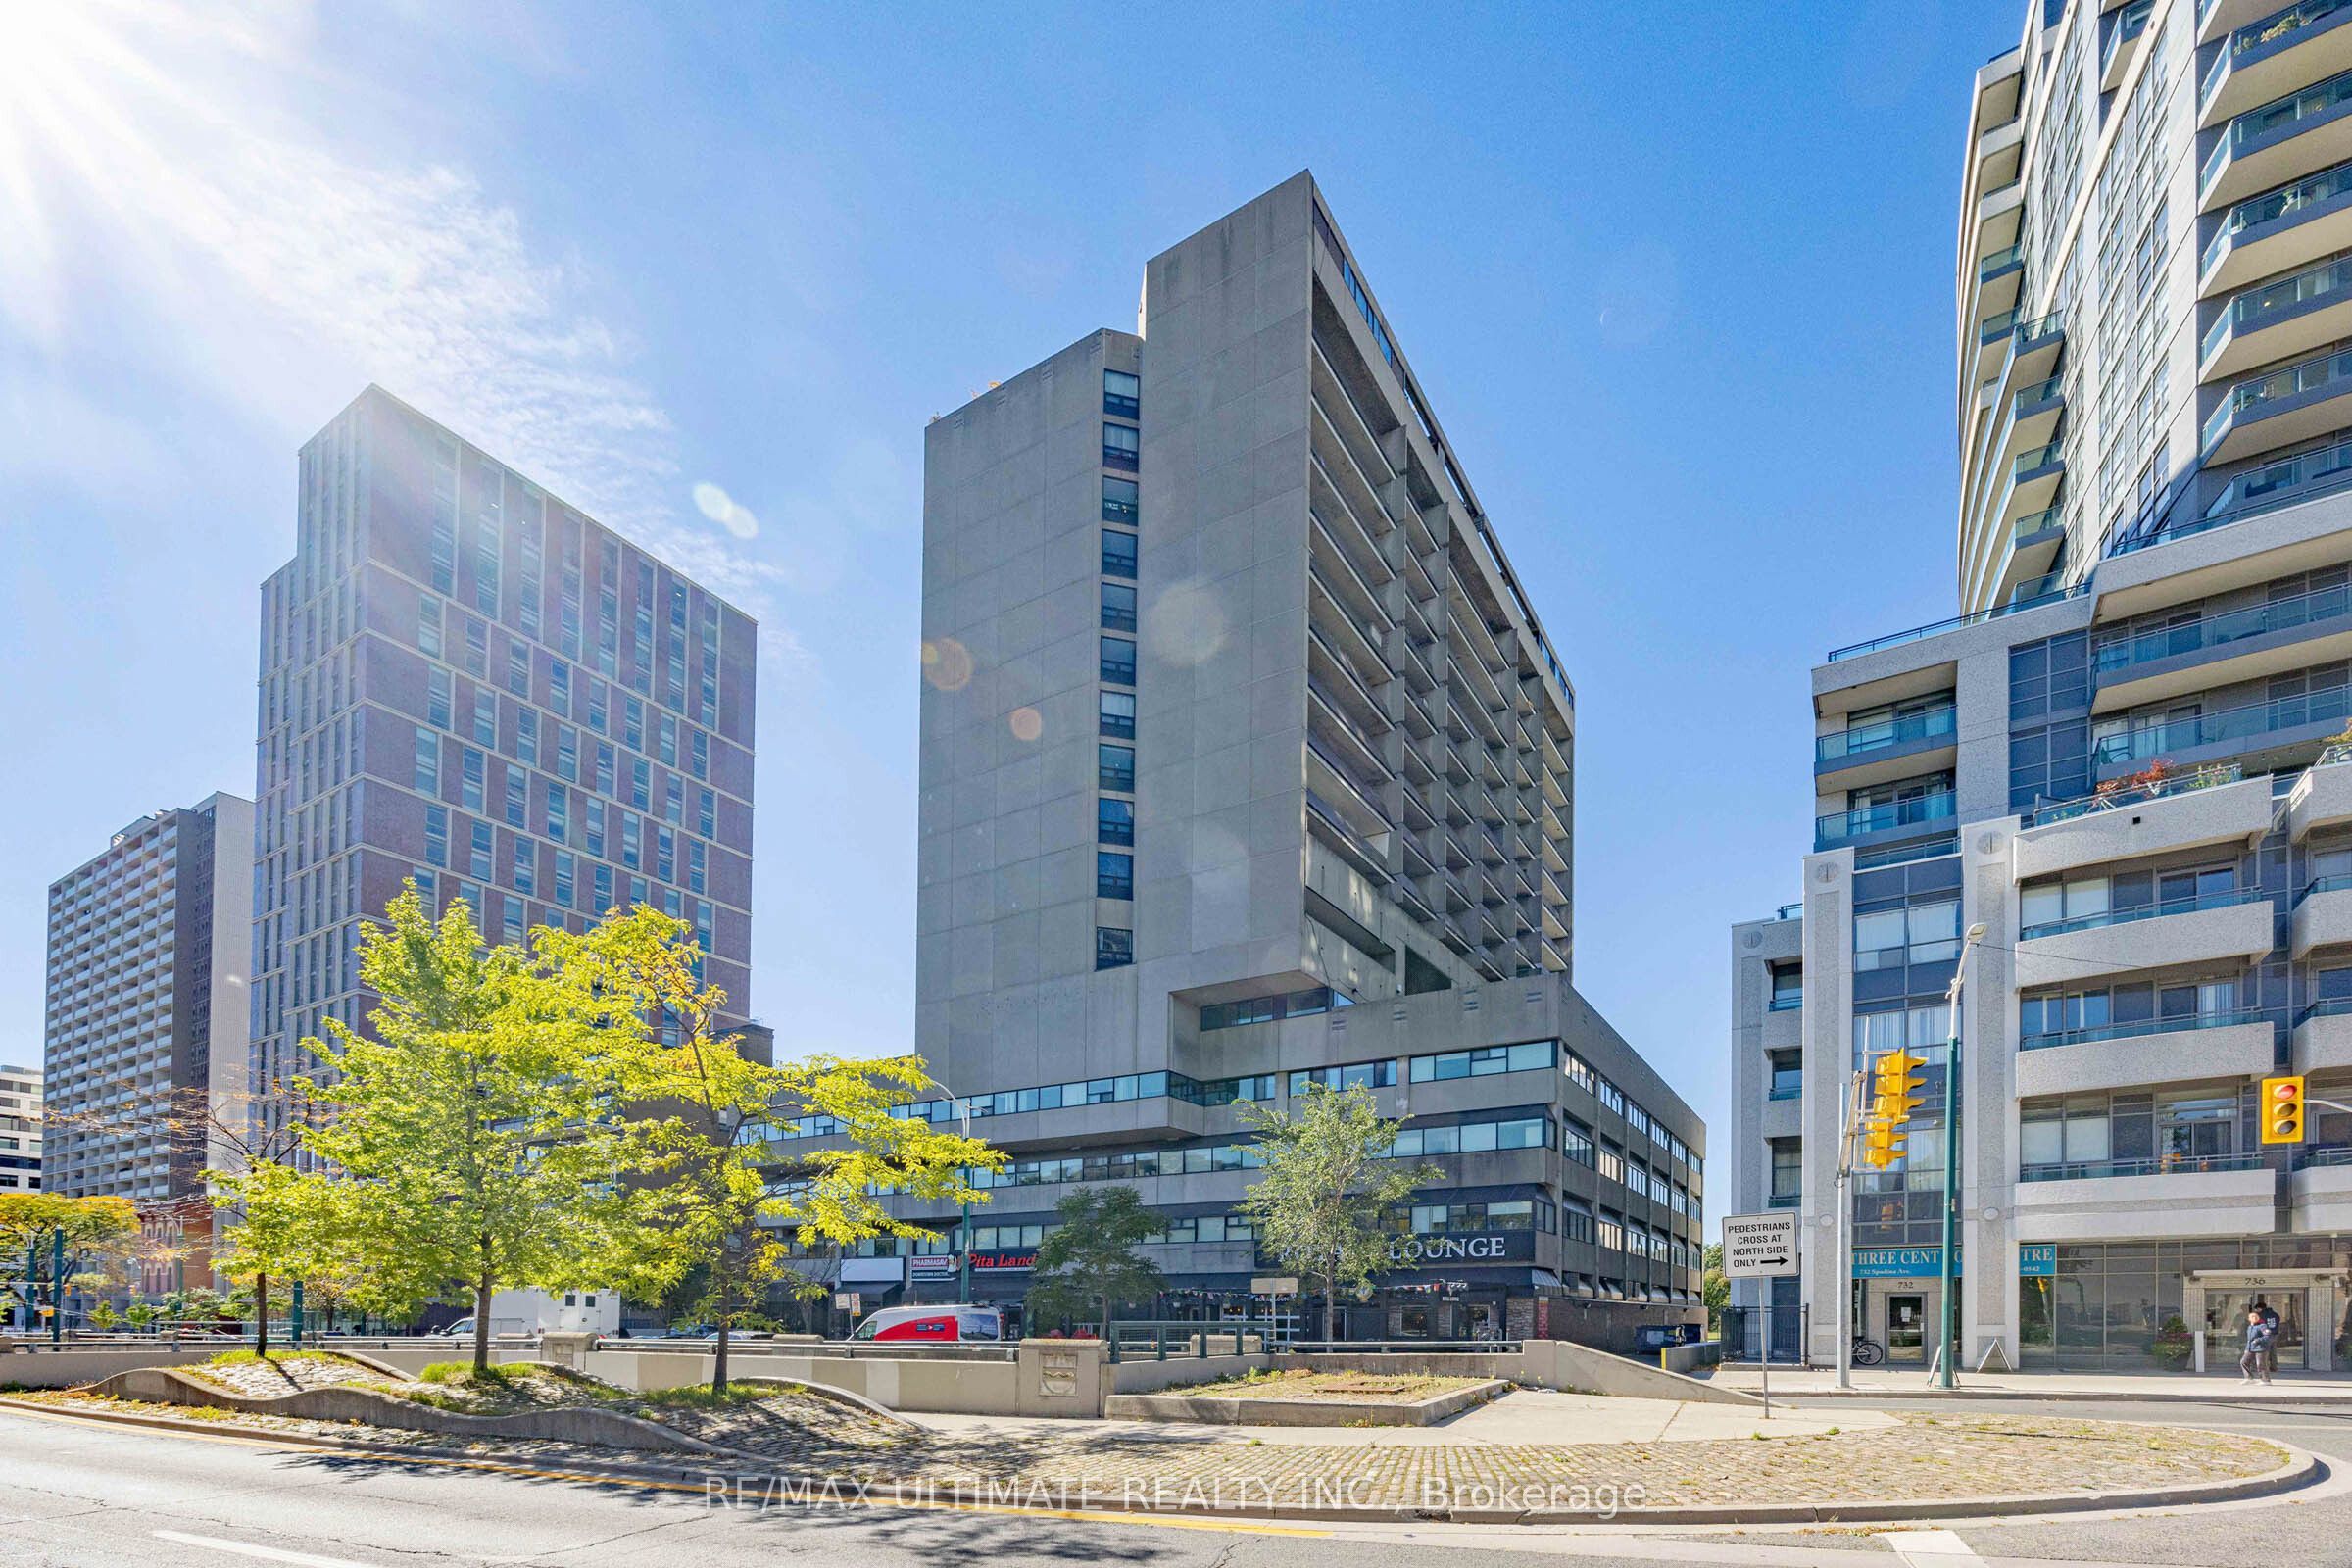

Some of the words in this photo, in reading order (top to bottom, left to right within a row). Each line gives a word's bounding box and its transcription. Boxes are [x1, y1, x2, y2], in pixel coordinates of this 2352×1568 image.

[1728, 1222, 1790, 1234] PEDESTRIANS
[1738, 1235, 1769, 1245] CROSS
[1771, 1234, 1782, 1243] AT
[1389, 1237, 1506, 1259] LOUNGE
[1733, 1247, 1764, 1256] NORTH
[1767, 1246, 1788, 1254] SIDE
[968, 1253, 994, 1267] Pita
[998, 1253, 1037, 1266] Land
[1734, 1259, 1756, 1268] ONLY
[1851, 1251, 1897, 1265] THREE
[2244, 1277, 2266, 1286] 736
